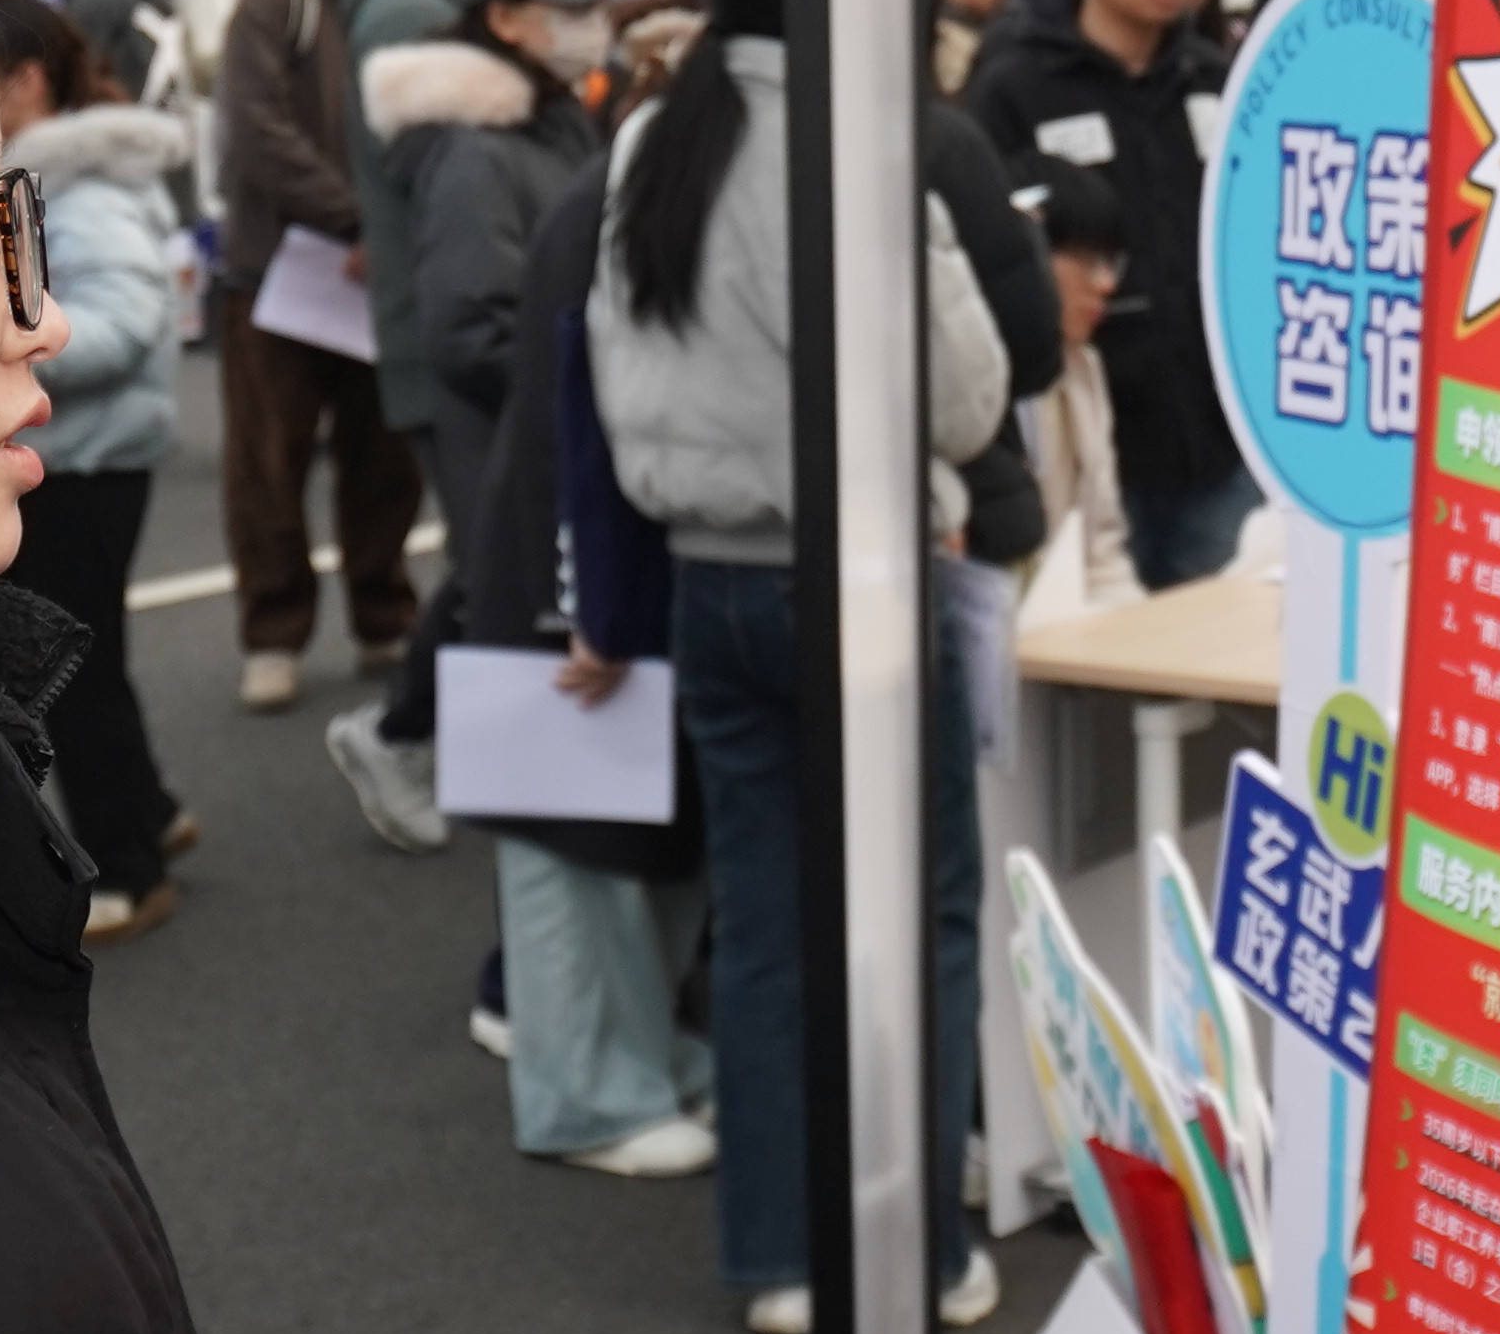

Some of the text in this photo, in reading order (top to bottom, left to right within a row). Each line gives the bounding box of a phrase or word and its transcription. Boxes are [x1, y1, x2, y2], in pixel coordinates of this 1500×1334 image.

[1279, 121, 1429, 278] 政策
[1275, 272, 1422, 436] 咨询
[1318, 714, 1387, 836] Hi
